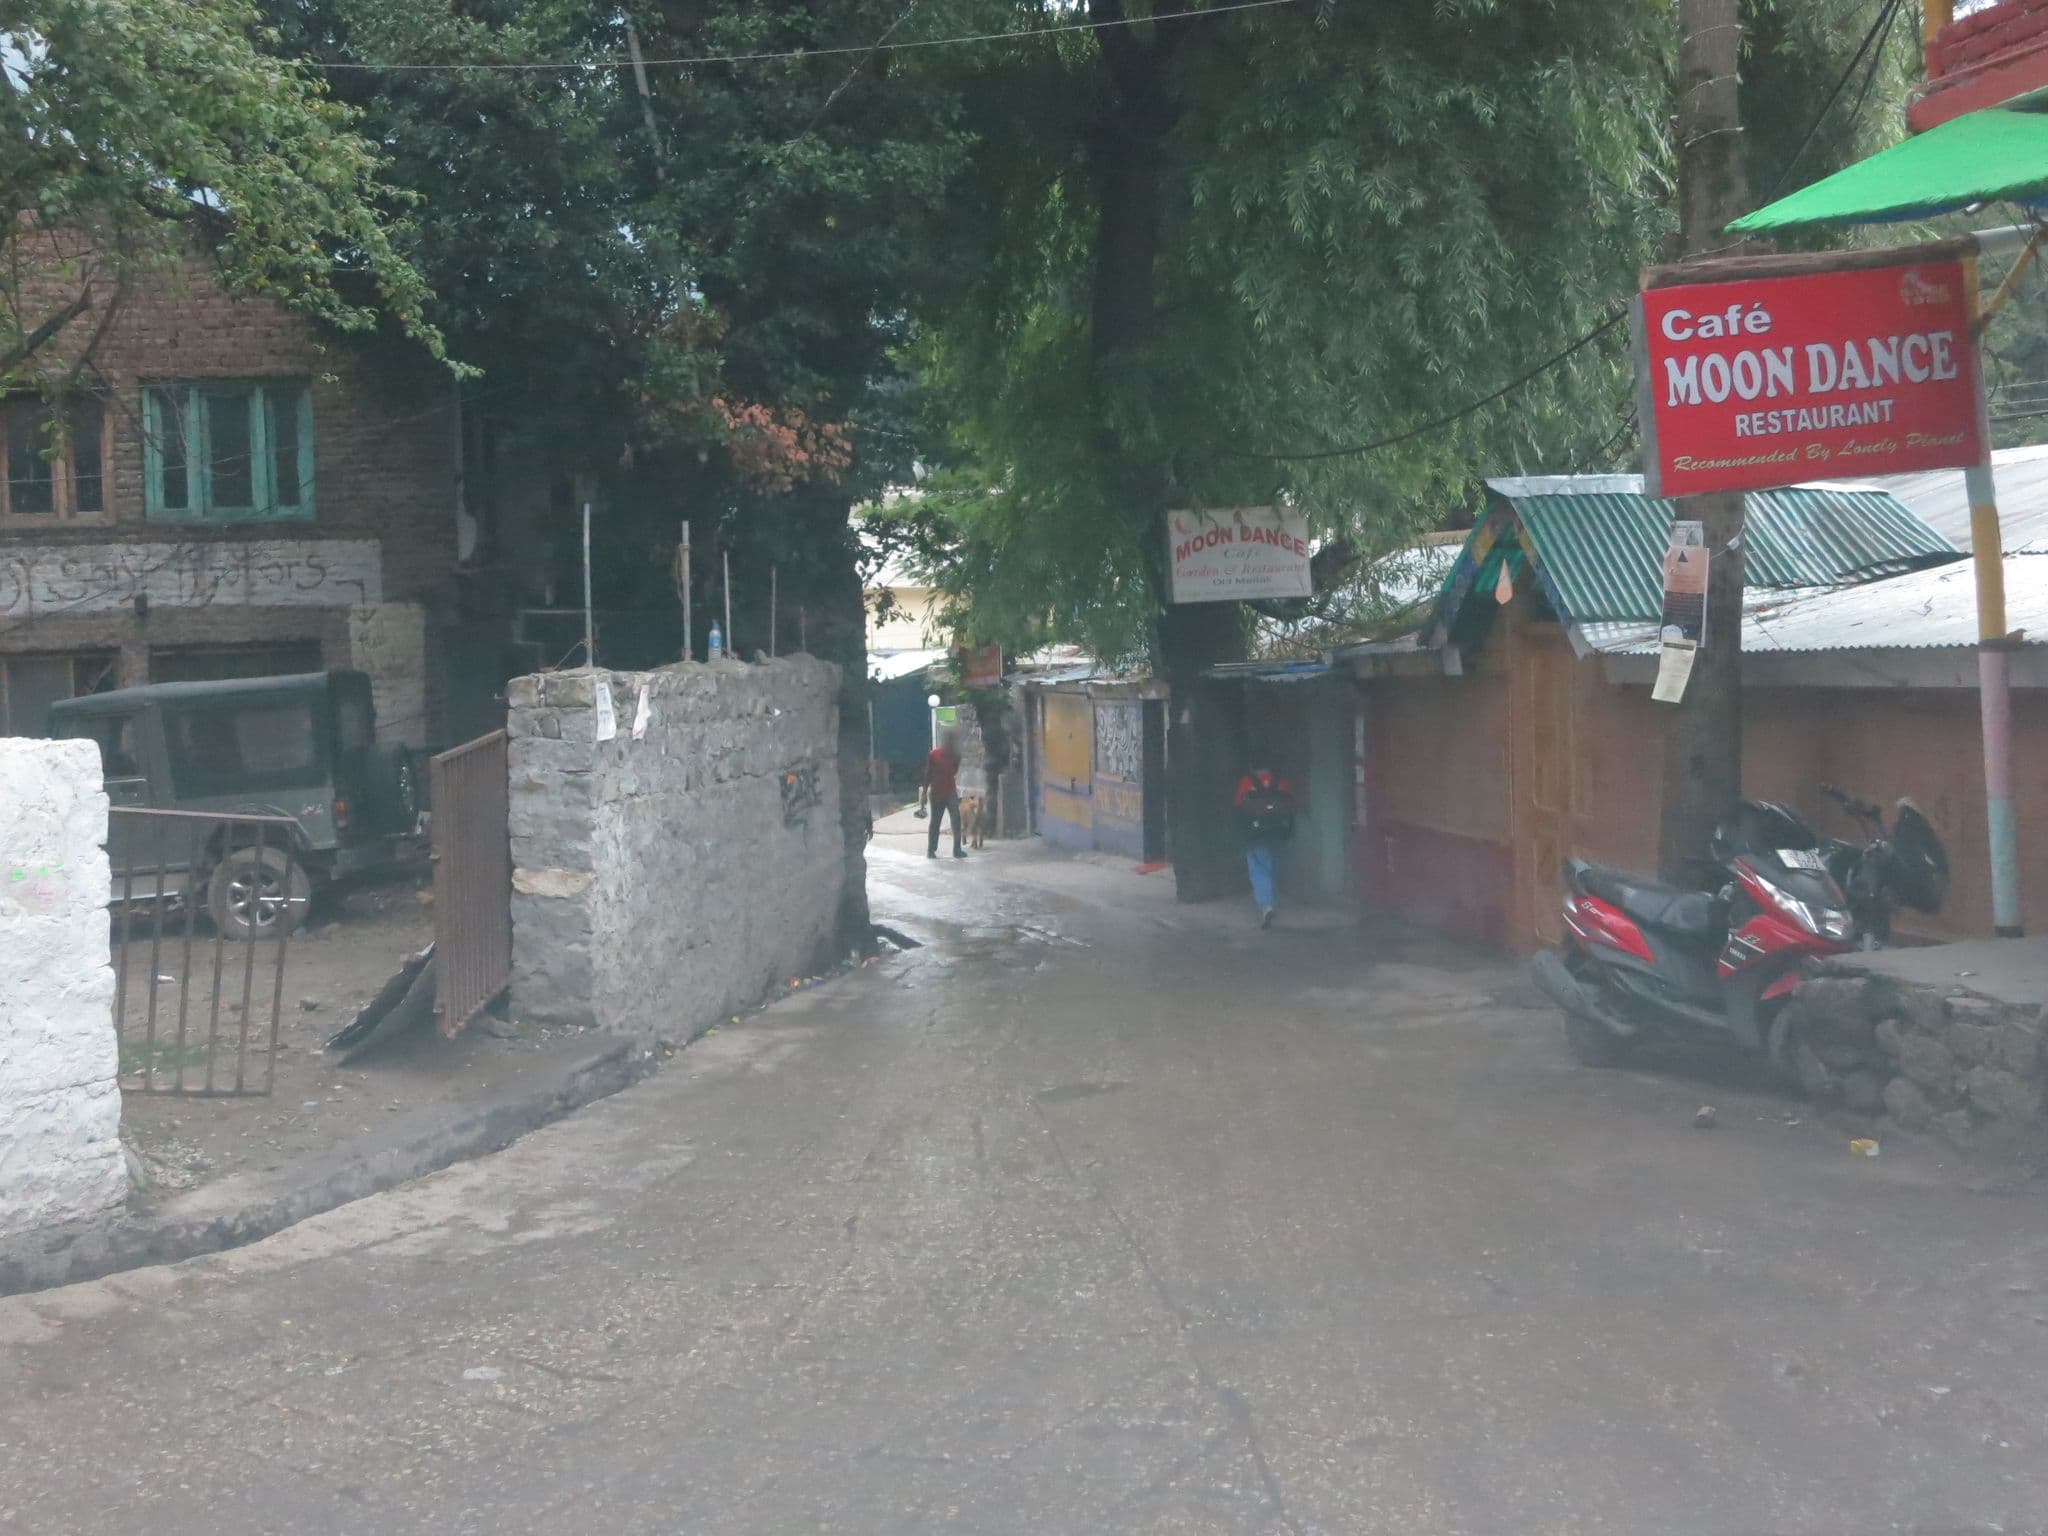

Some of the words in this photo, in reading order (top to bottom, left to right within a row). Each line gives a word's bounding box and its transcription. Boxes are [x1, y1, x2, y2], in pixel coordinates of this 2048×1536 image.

[1661, 302, 1772, 341] Café
[1663, 346, 1796, 407] MOON
[1805, 330, 1958, 393] DANCE
[1735, 399, 1894, 437] RESTAURANT
[1673, 448, 1800, 473] Recommended
[1804, 443, 1832, 461] By
[1838, 438, 1898, 457] Lonely
[1176, 527, 1233, 562] MOON
[1240, 526, 1307, 558] DANCE
